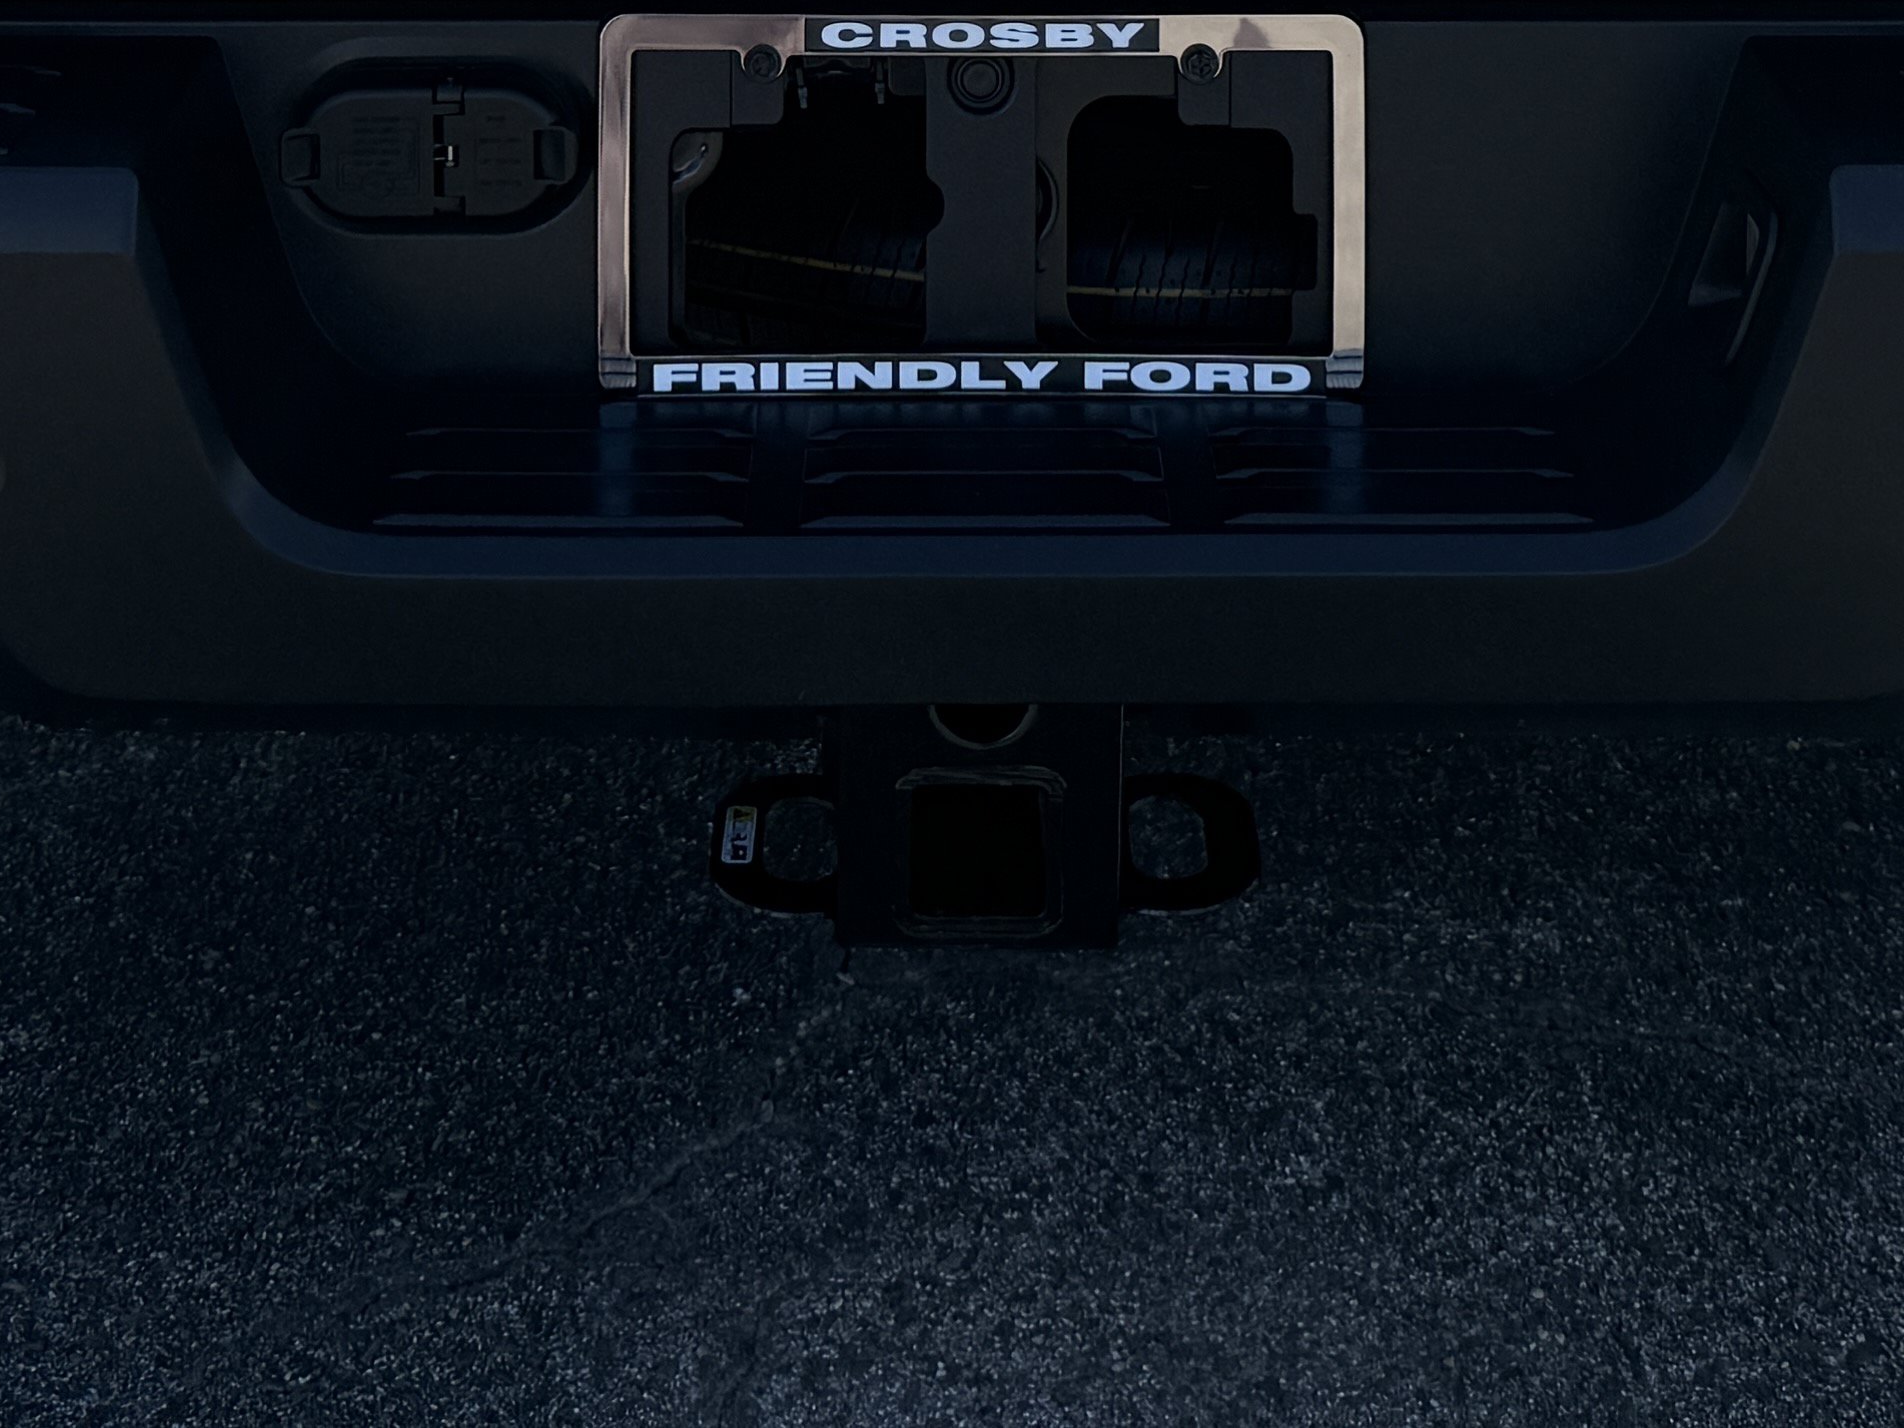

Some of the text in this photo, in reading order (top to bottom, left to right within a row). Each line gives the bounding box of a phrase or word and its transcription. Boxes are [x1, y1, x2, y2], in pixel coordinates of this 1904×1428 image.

[820, 21, 1146, 50] CROSBY
[652, 360, 1312, 393] FRIENDLY FORD
